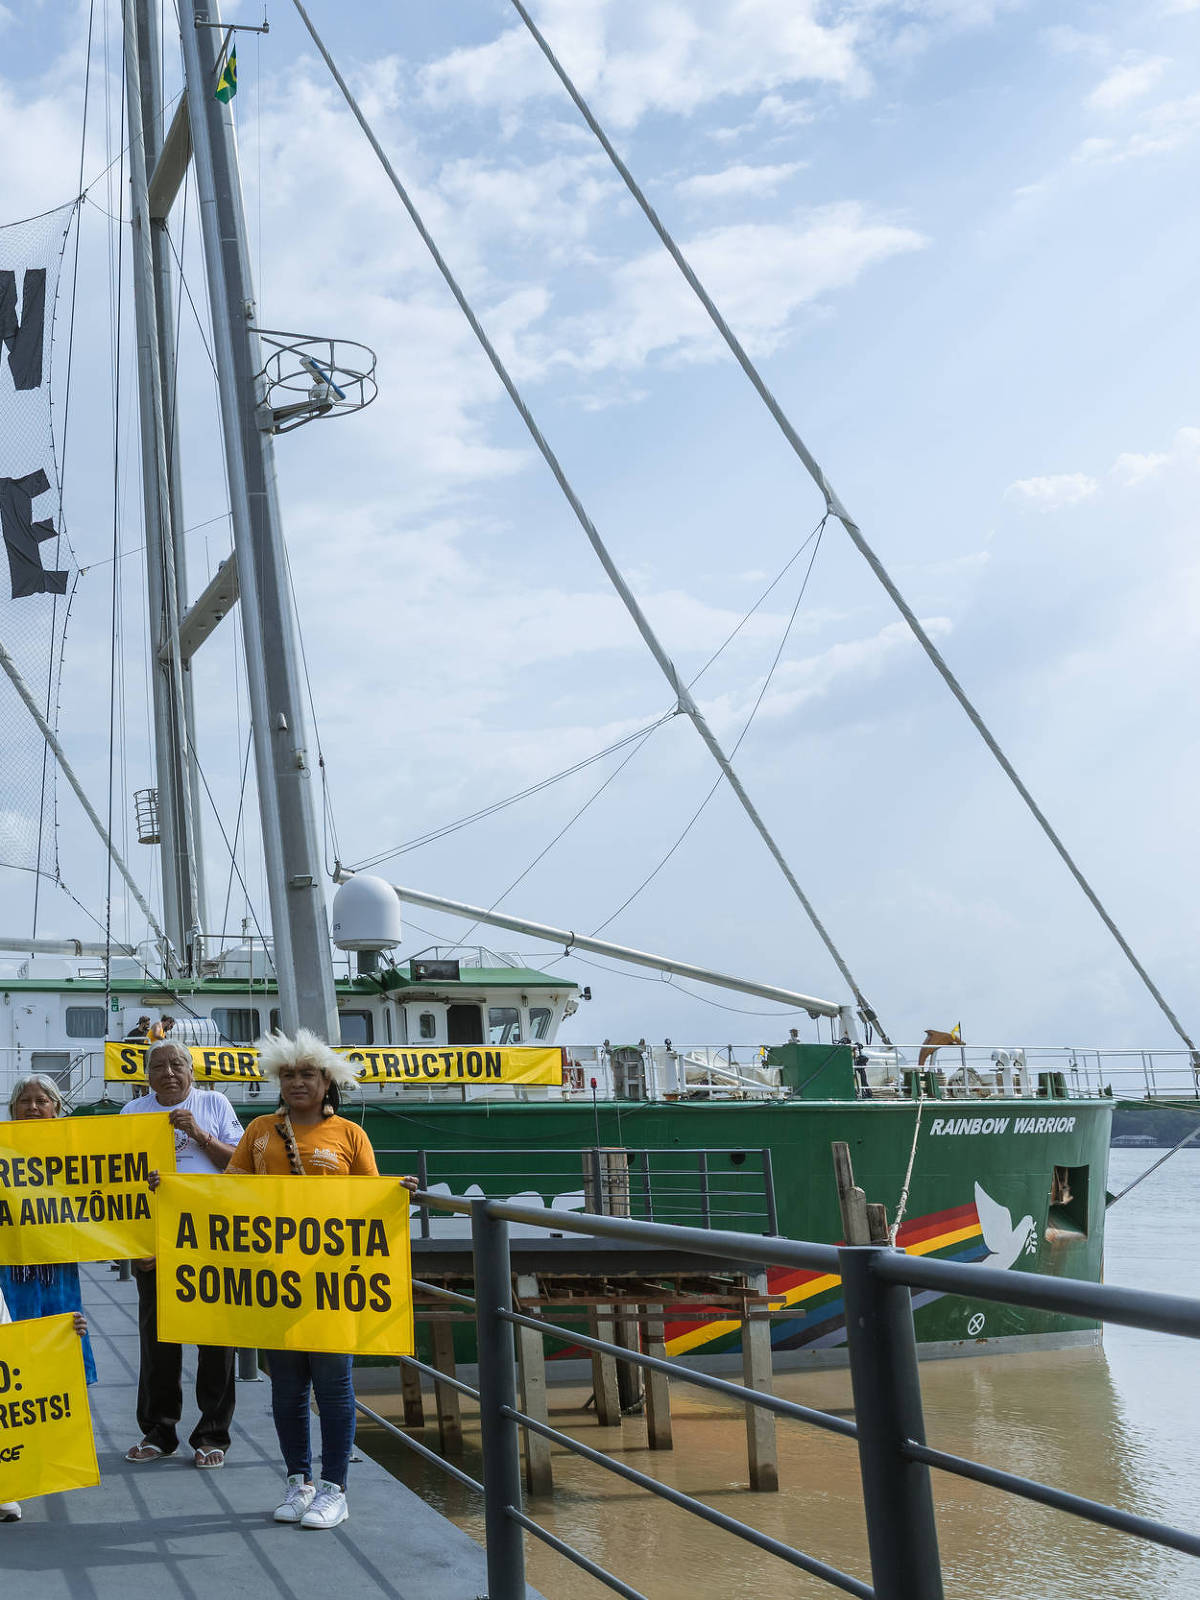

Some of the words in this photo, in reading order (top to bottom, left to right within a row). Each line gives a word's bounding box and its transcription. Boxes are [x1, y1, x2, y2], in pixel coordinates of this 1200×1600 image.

[929, 1117, 1011, 1136] RAINBOW
[1013, 1116, 1077, 1135] WARRIOR
[19, 1189, 152, 1226] AMAZÔNIA
[175, 1211, 199, 1249] A
[208, 1213, 391, 1257] RESPOSTA
[175, 1264, 302, 1309] SOMOS
[315, 1264, 392, 1313] NÓS
